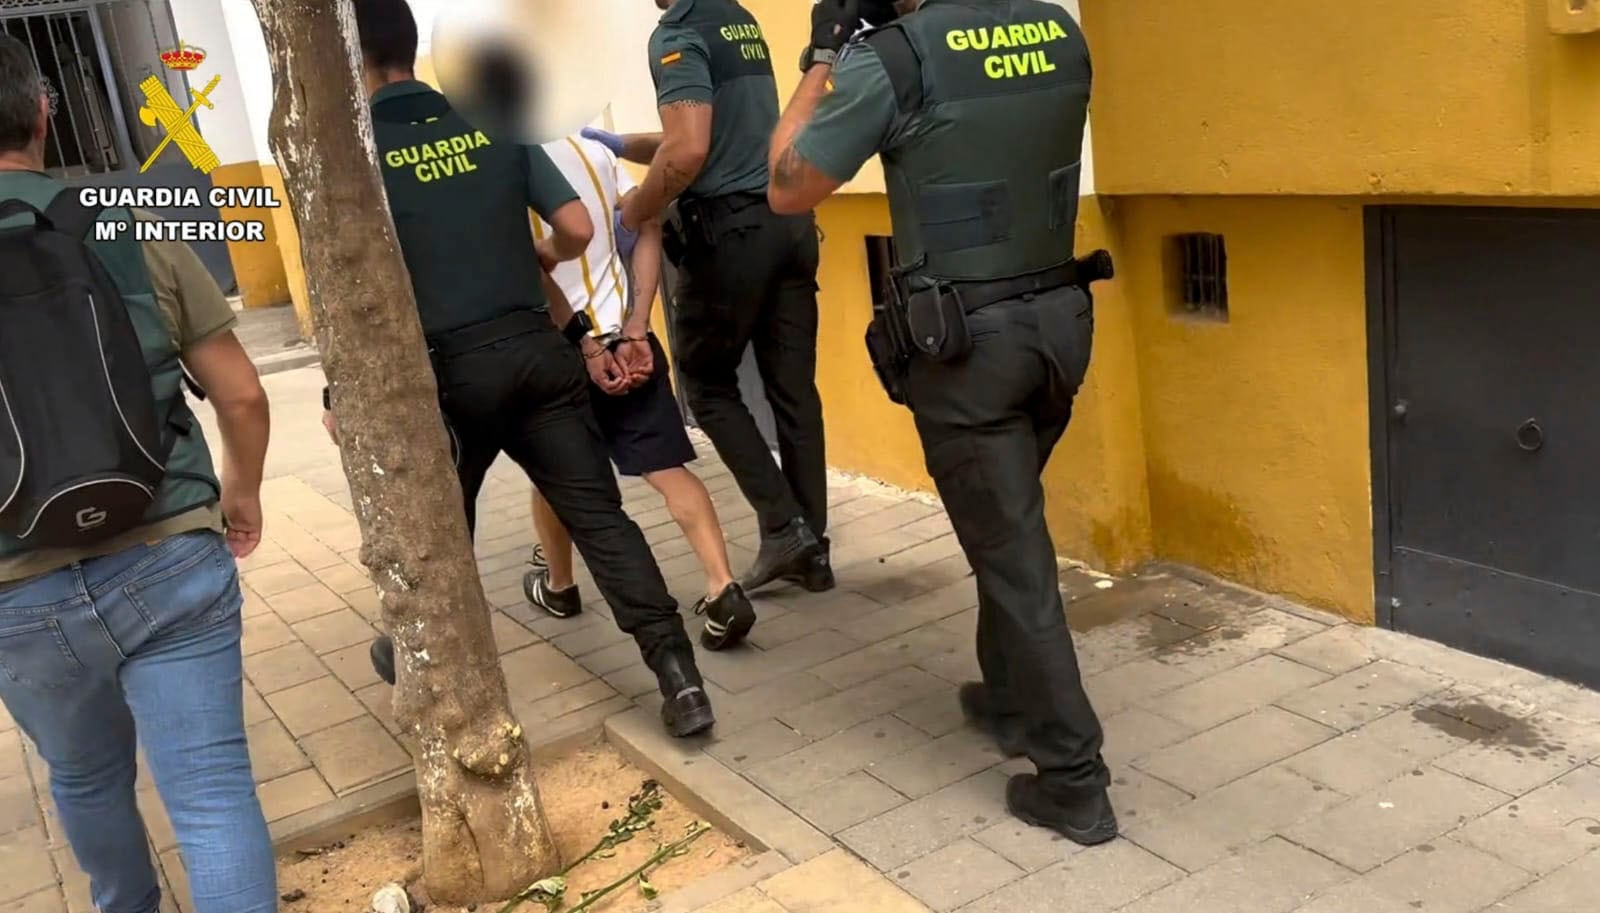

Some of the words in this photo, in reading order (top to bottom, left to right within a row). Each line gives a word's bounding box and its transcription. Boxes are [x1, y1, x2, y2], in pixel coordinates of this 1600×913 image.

[720, 24, 761, 41] GUARD
[945, 19, 1068, 51] GUARDIA
[740, 43, 766, 60] CIVIL
[984, 50, 1057, 79] CIVIL
[385, 130, 491, 168] GUARDIA
[415, 153, 477, 182] CIVIL
